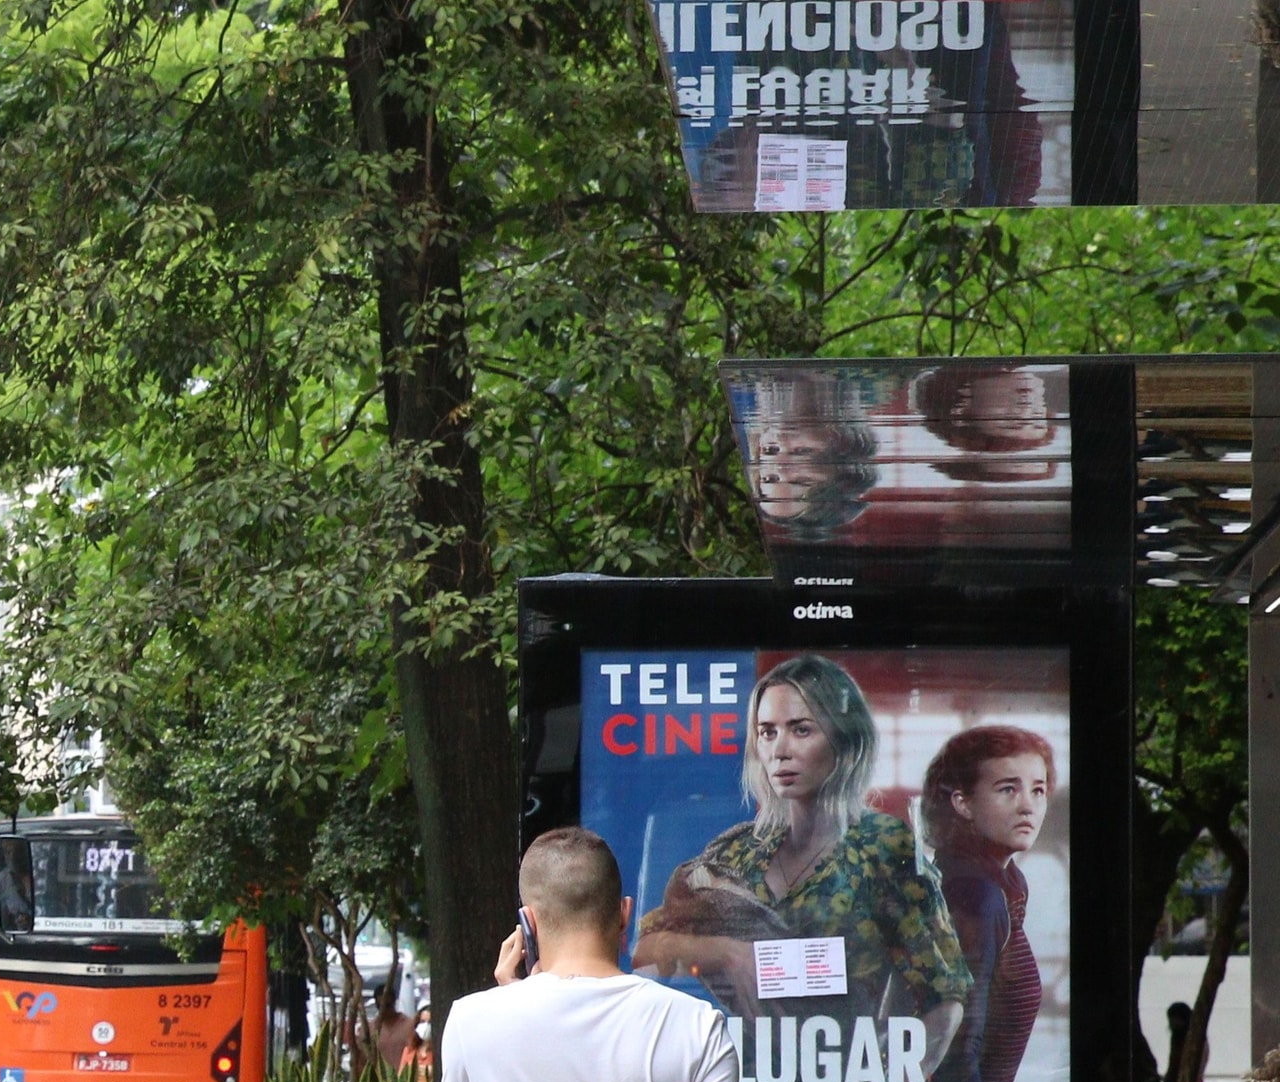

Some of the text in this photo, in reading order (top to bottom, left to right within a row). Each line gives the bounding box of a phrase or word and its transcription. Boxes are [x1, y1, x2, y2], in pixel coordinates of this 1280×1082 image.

[793, 601, 854, 620] otima
[600, 662, 738, 705] TELE
[601, 713, 739, 756] CINE
[101, 920, 124, 930] 181
[158, 995, 212, 1009] 8 2397
